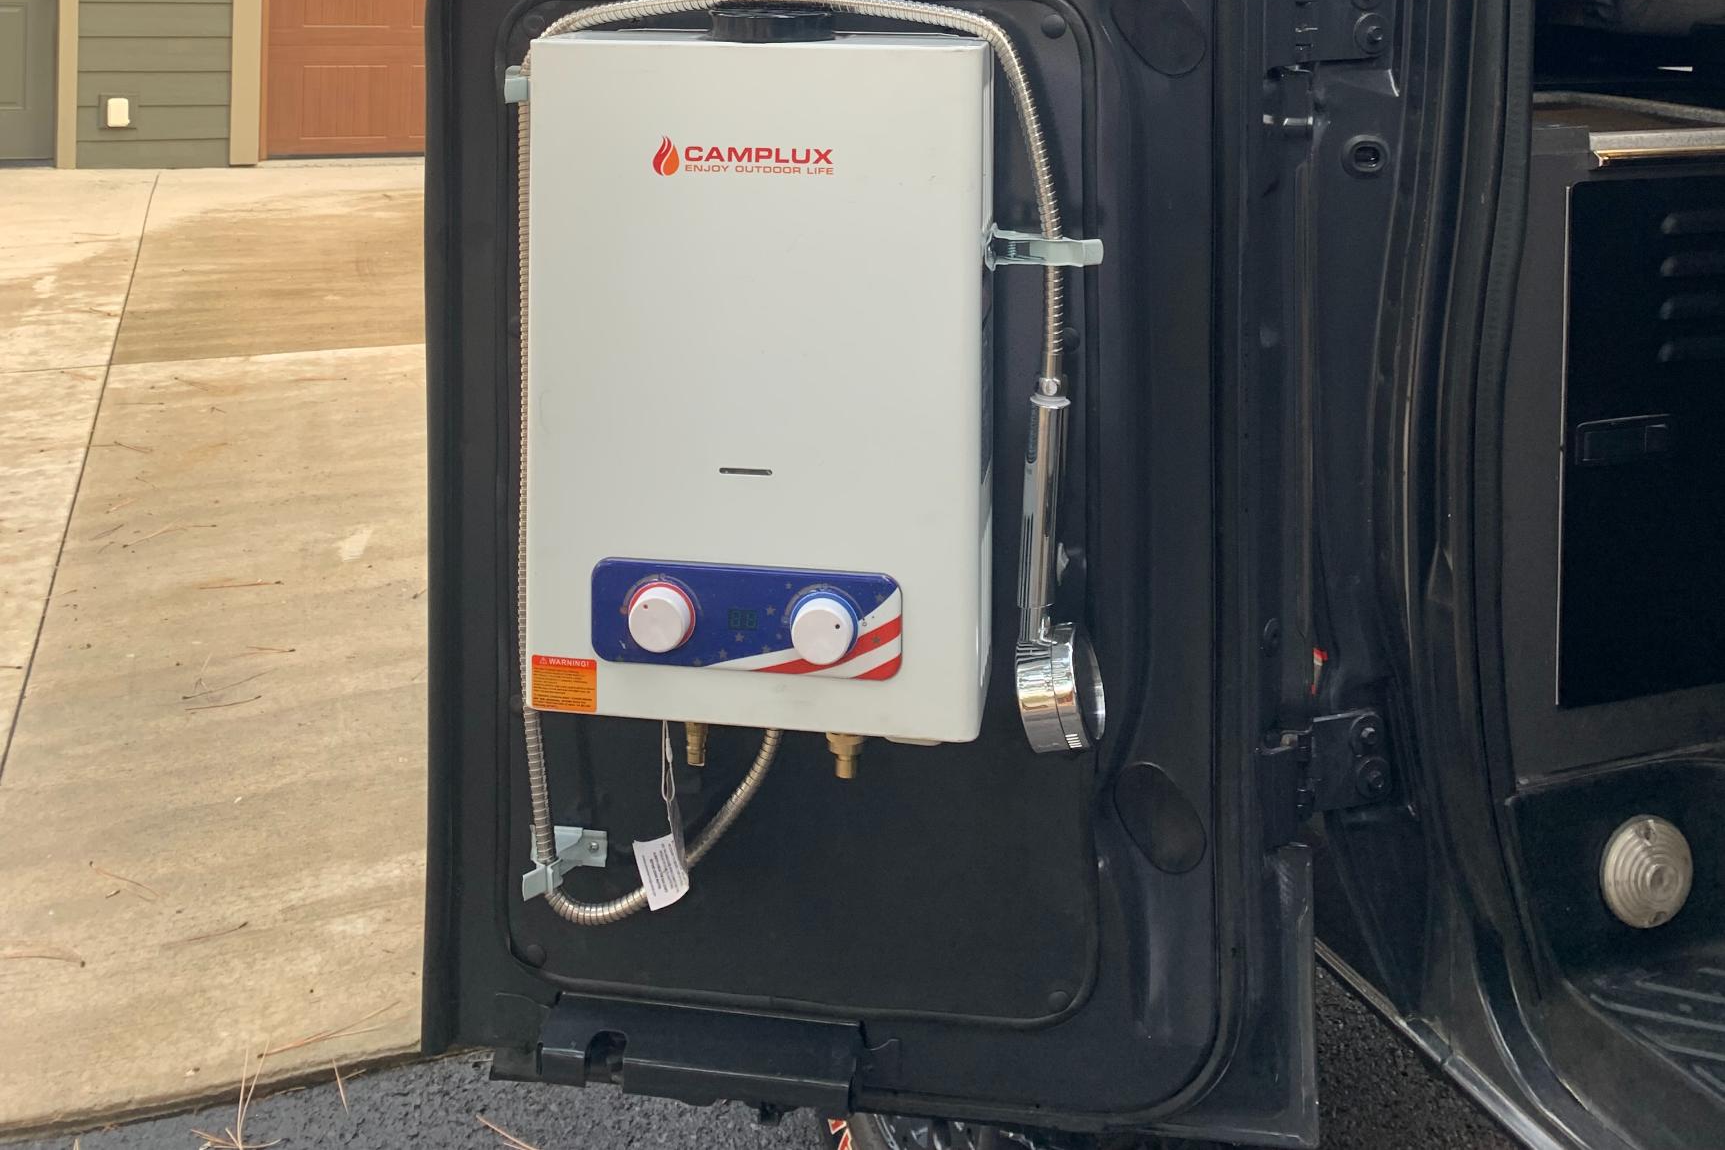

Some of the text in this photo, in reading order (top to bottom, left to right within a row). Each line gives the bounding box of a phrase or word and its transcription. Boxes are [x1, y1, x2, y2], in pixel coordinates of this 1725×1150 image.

[684, 146, 833, 164] CAMPLUX
[734, 165, 802, 175] OUTDOOR
[807, 167, 834, 175] LIFE
[548, 658, 590, 667] WARNING!
